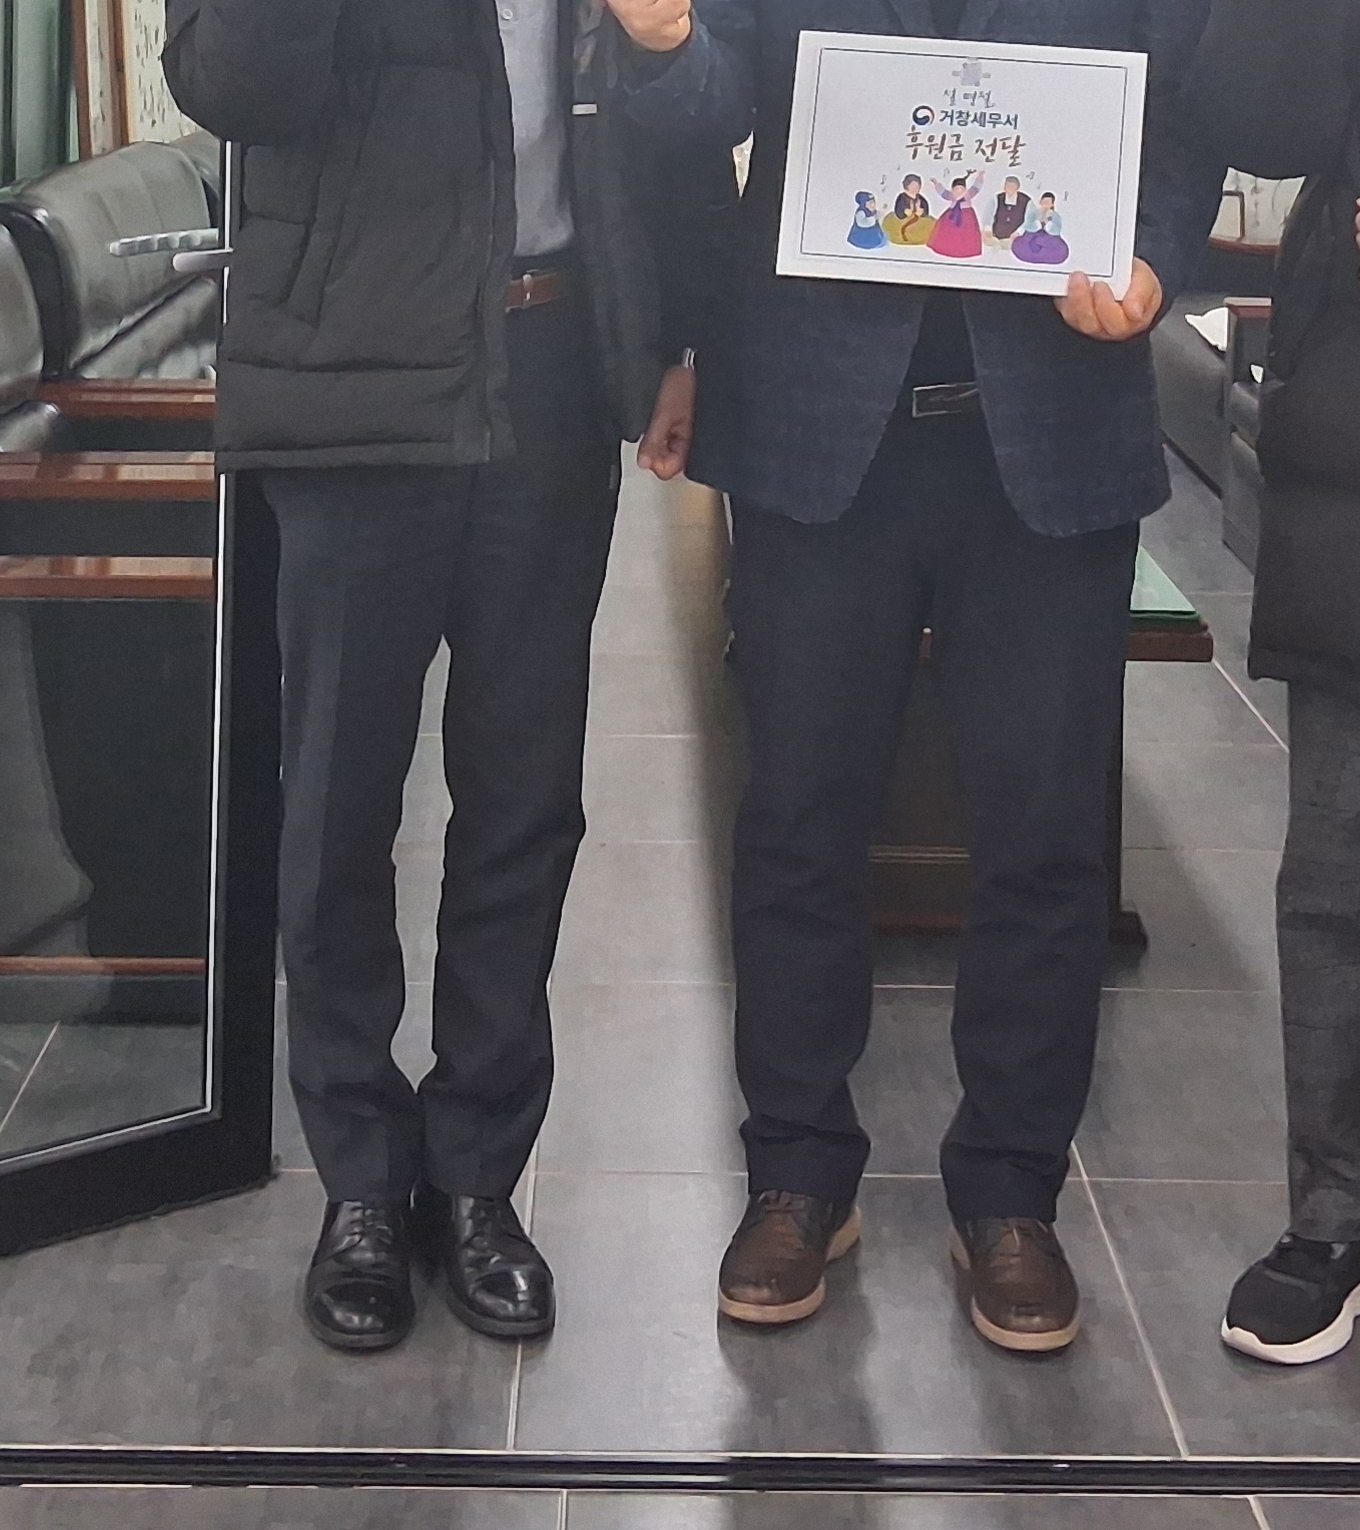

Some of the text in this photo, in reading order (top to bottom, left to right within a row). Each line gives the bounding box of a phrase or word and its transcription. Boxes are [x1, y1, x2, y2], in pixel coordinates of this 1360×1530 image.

[939, 109, 1019, 130] 거창세무서
[905, 125, 1026, 167] 후원금 전달
